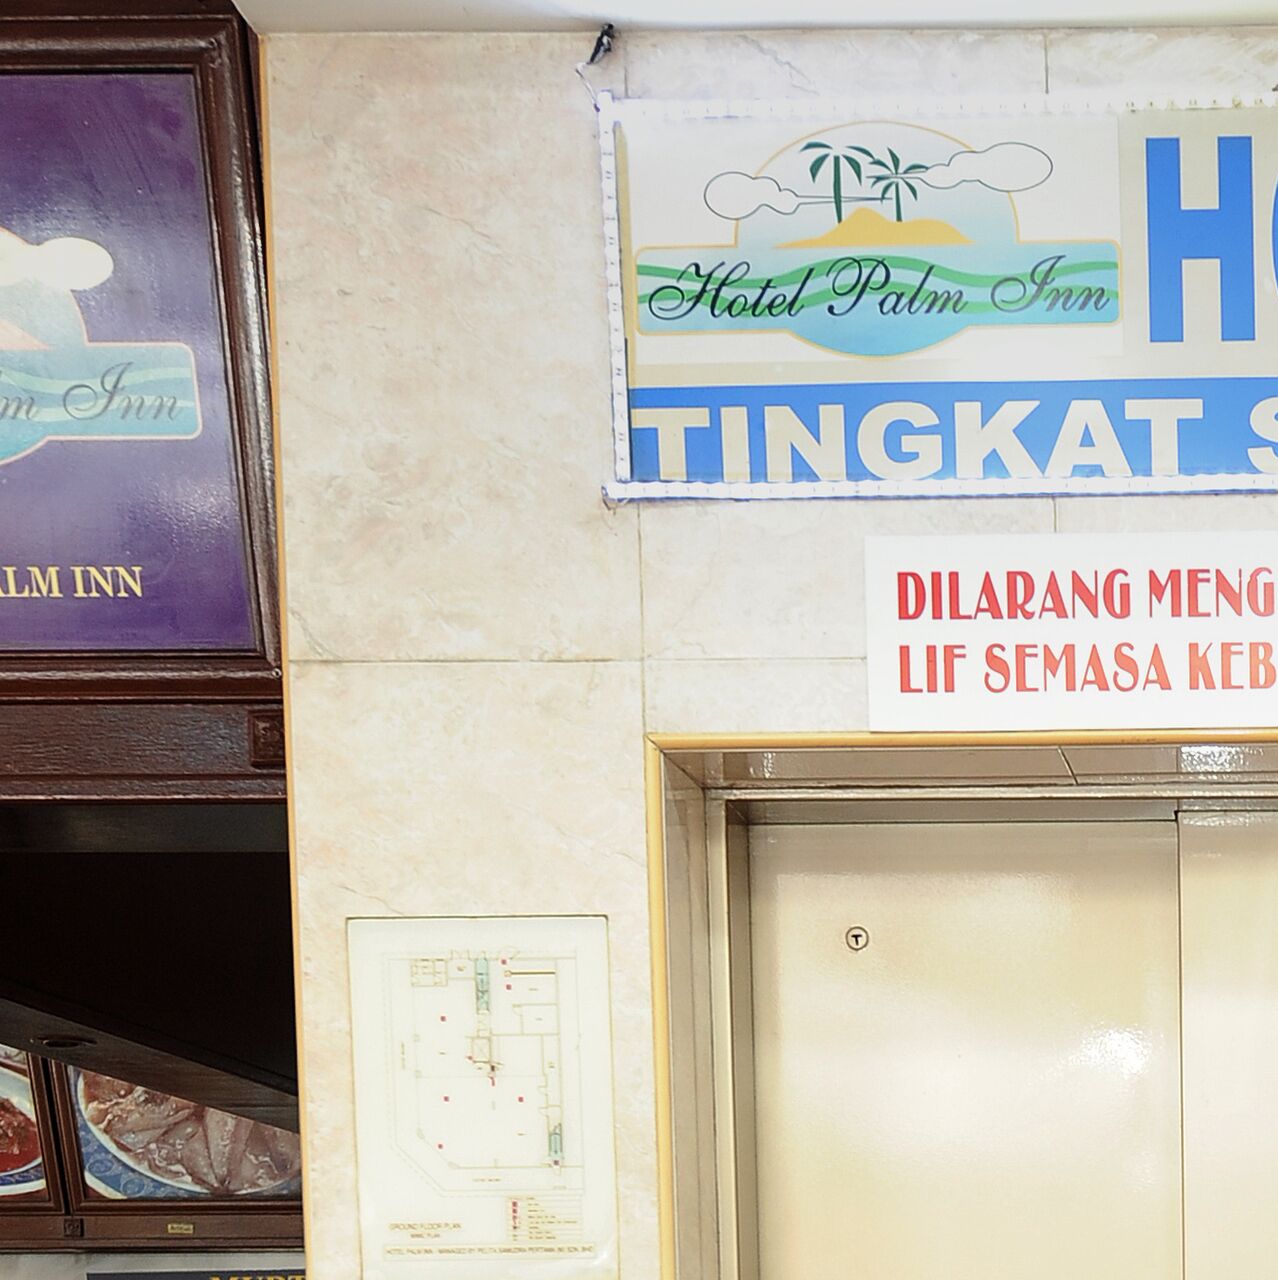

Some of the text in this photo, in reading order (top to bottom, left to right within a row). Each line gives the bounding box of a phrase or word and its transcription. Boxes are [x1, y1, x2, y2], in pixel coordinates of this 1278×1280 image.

[648, 254, 1111, 321] Hotel Palm Inn
[63, 361, 181, 422] Inn
[630, 398, 1203, 483] TINGKAT
[69, 565, 143, 599] INN
[897, 568, 1131, 621] DILARANG
[899, 643, 967, 694] LIF
[984, 641, 1172, 694] SEMASA
